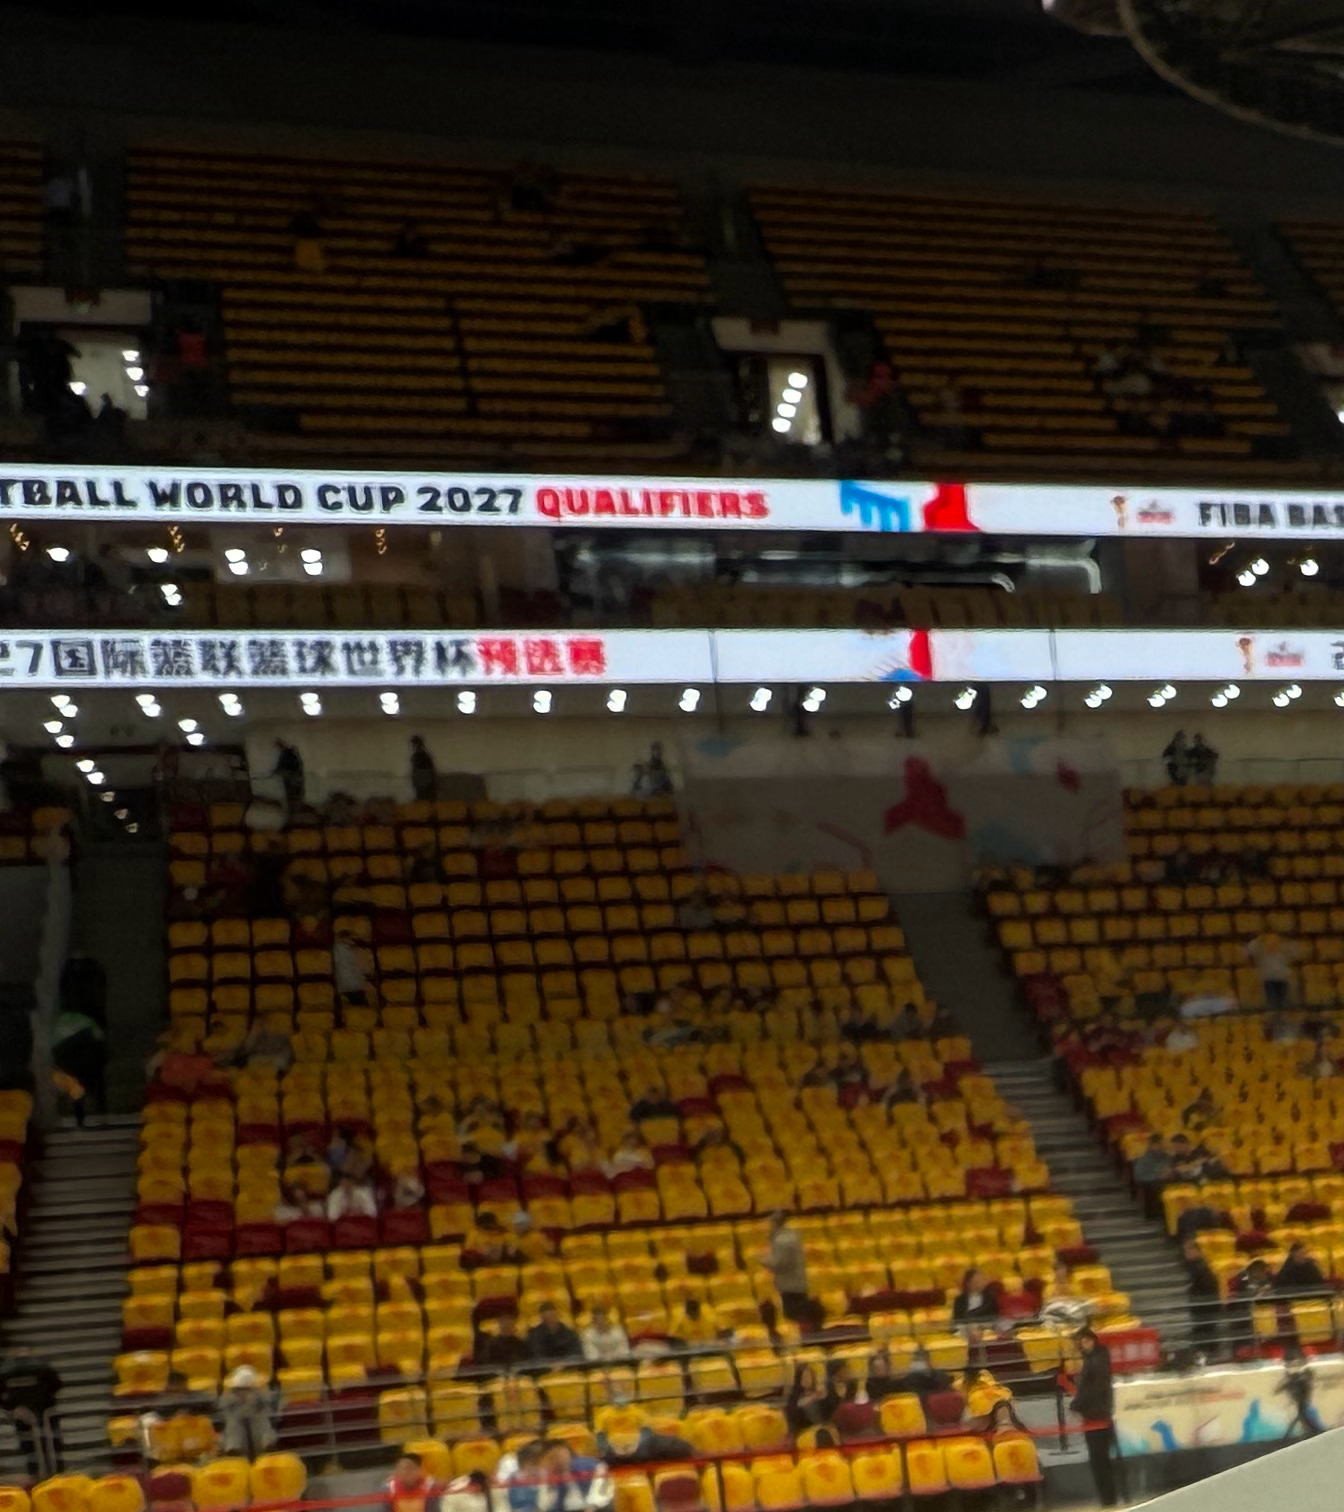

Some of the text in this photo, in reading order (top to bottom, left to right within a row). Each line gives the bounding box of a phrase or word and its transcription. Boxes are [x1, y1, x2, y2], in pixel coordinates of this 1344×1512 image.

[149, 480, 303, 510] WORLD
[317, 484, 405, 513] CUP
[417, 486, 523, 513] 2027
[536, 487, 770, 521] QUALIFIERS
